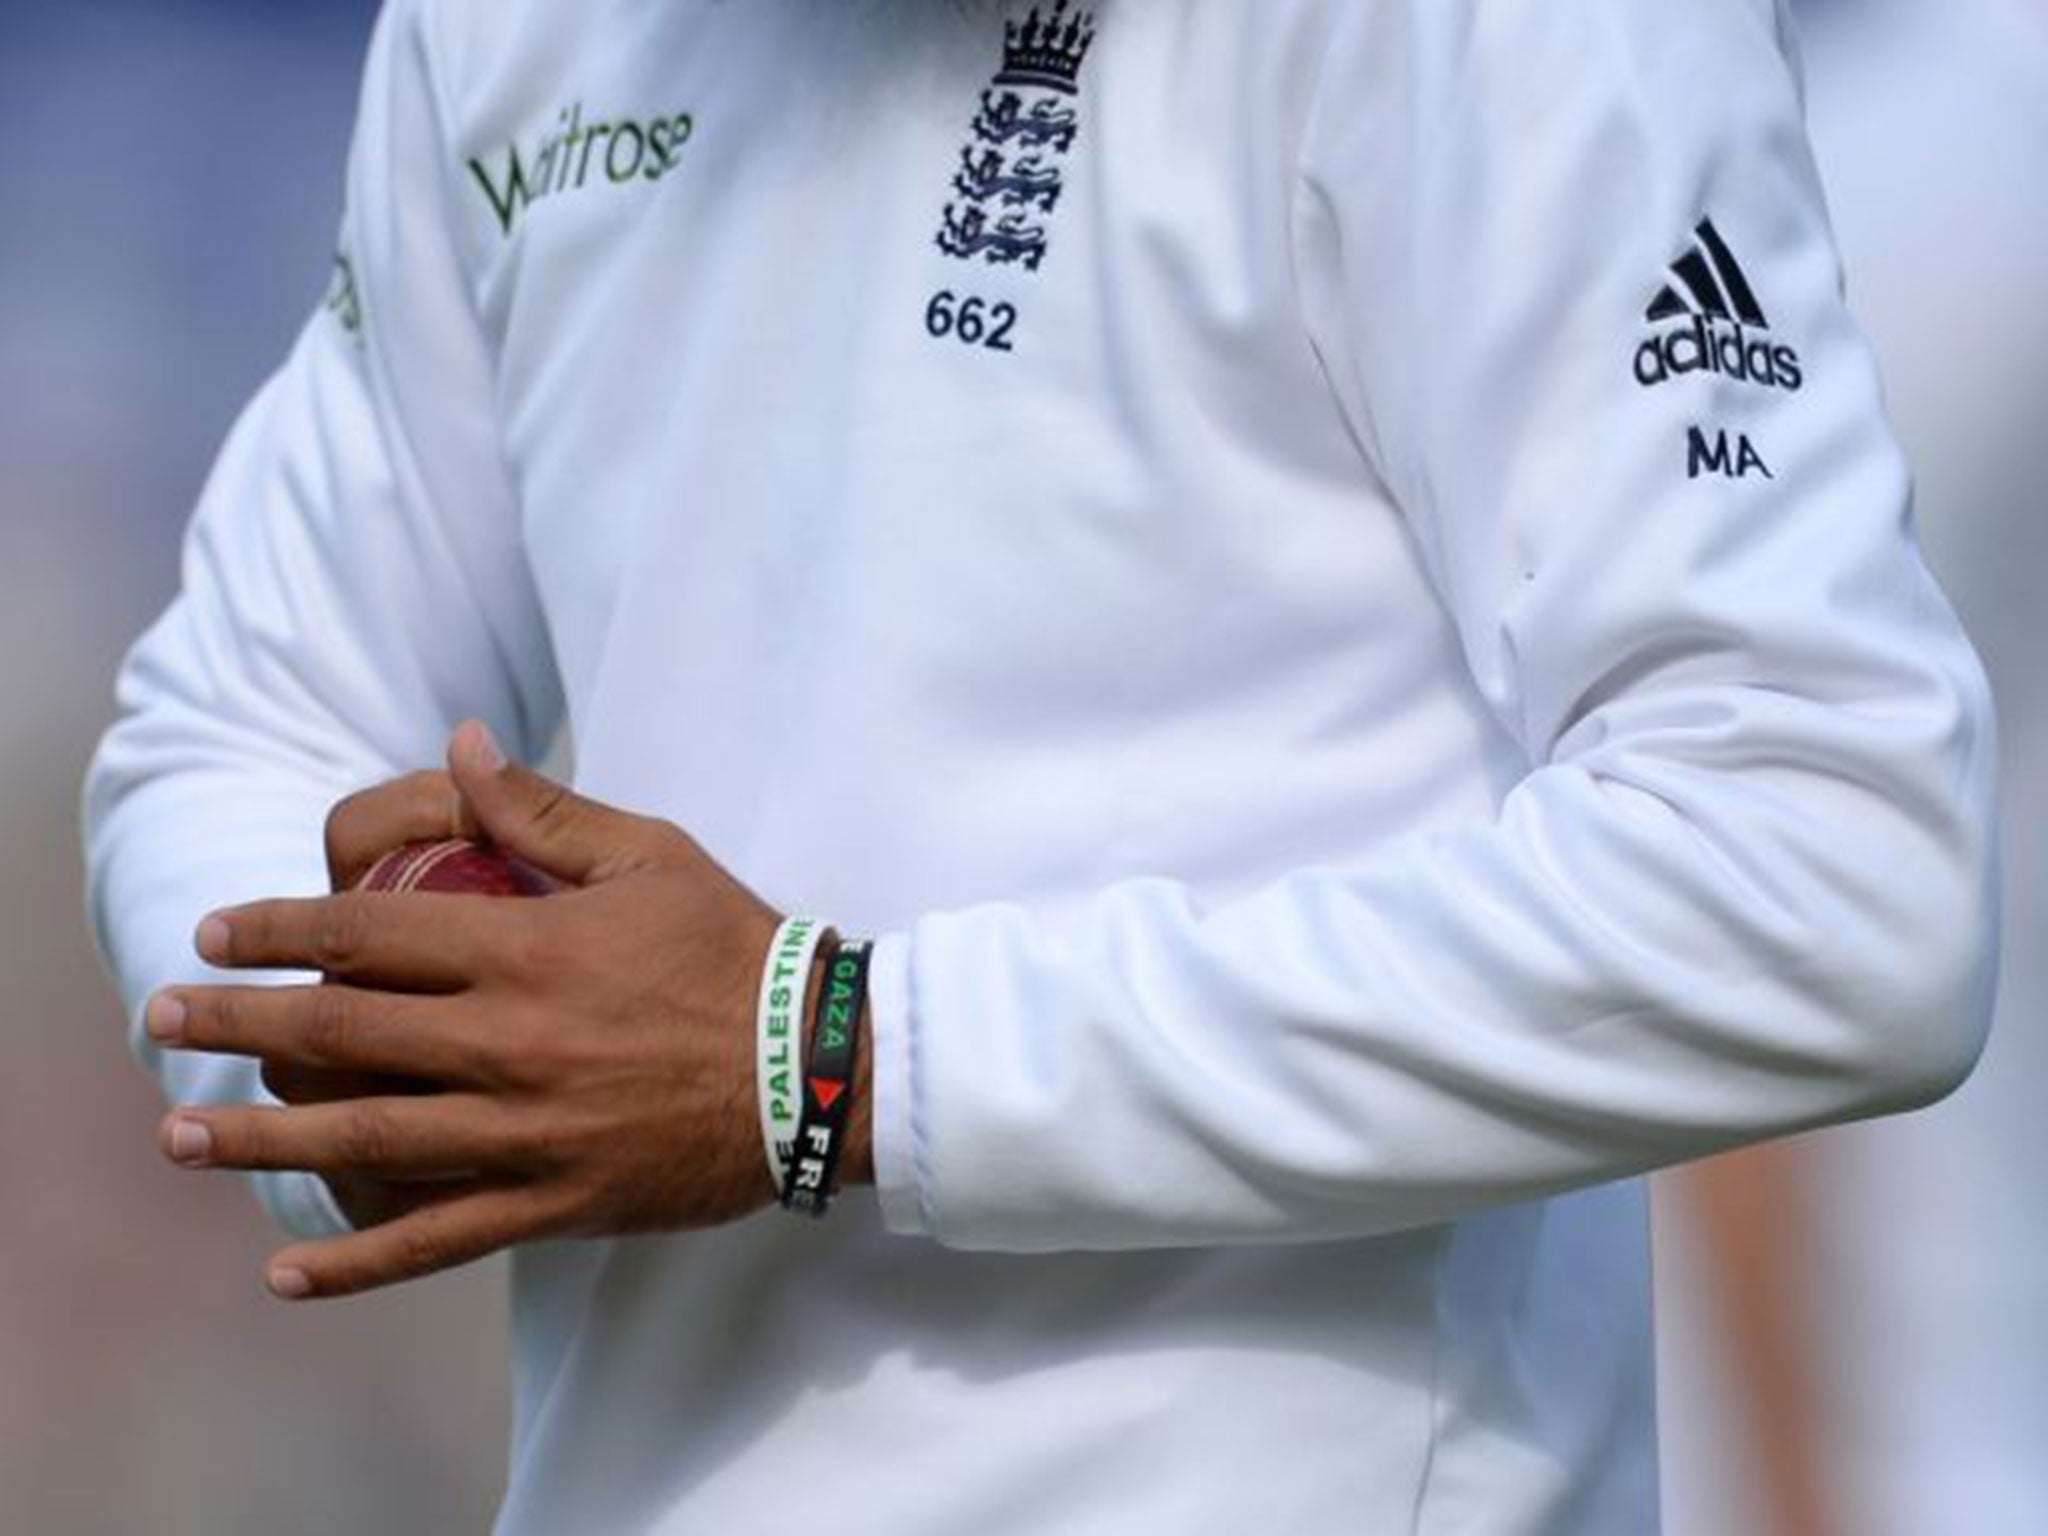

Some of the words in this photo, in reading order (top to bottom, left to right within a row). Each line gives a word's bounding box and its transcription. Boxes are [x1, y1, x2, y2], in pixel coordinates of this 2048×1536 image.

[926, 290, 1016, 352] 662
[1633, 313, 1802, 391] adidas
[1687, 424, 1774, 479] MA
[821, 960, 859, 1050] GAZA
